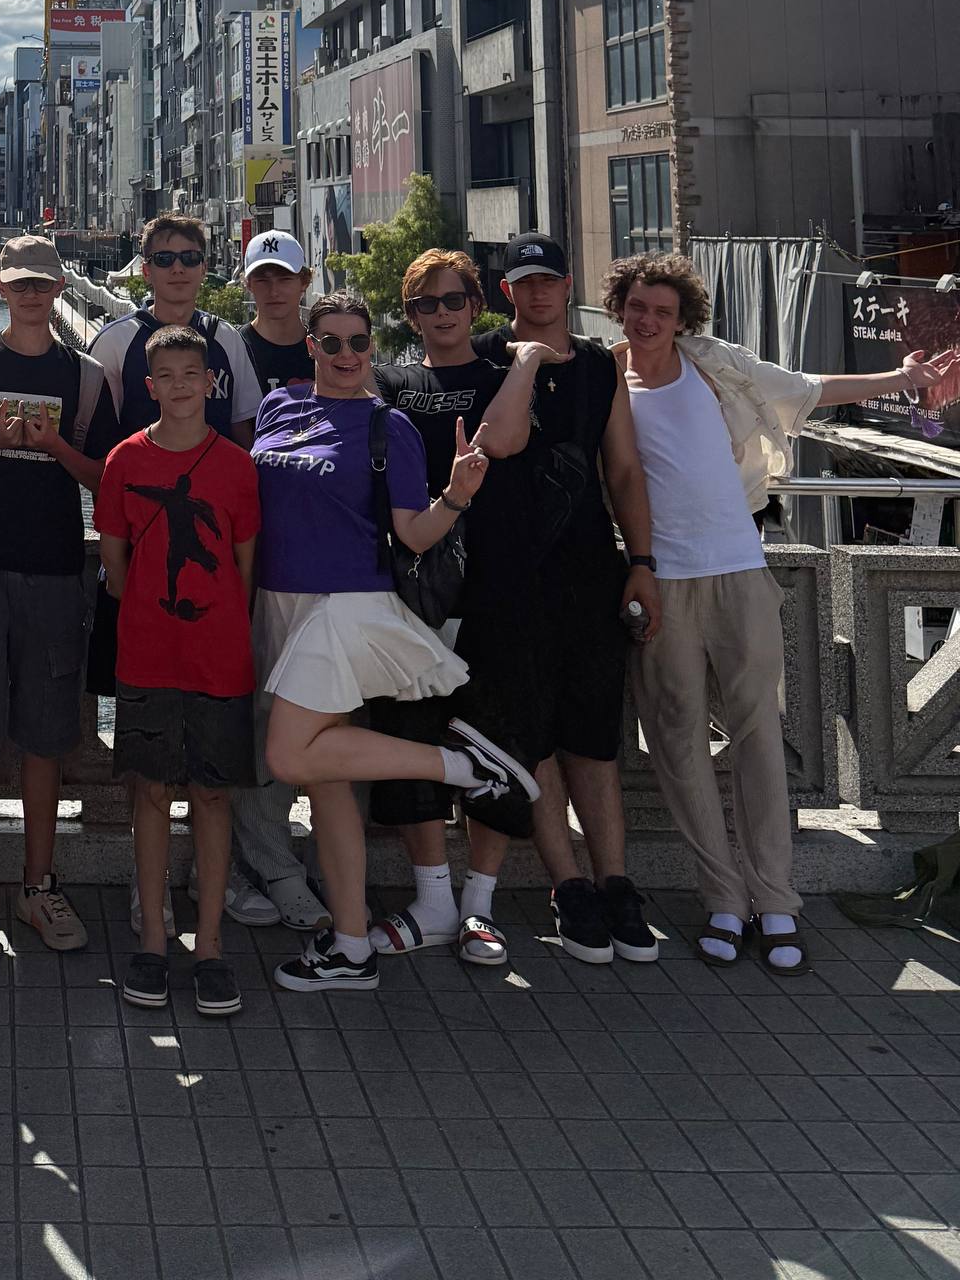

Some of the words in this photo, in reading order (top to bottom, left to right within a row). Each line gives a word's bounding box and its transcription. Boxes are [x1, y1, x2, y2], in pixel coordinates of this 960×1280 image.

[256, 36, 279, 142] 富士ホームサービス
[853, 296, 910, 326] ステーキ
[853, 326, 877, 340] STEAK
[397, 389, 476, 414] GUESS
